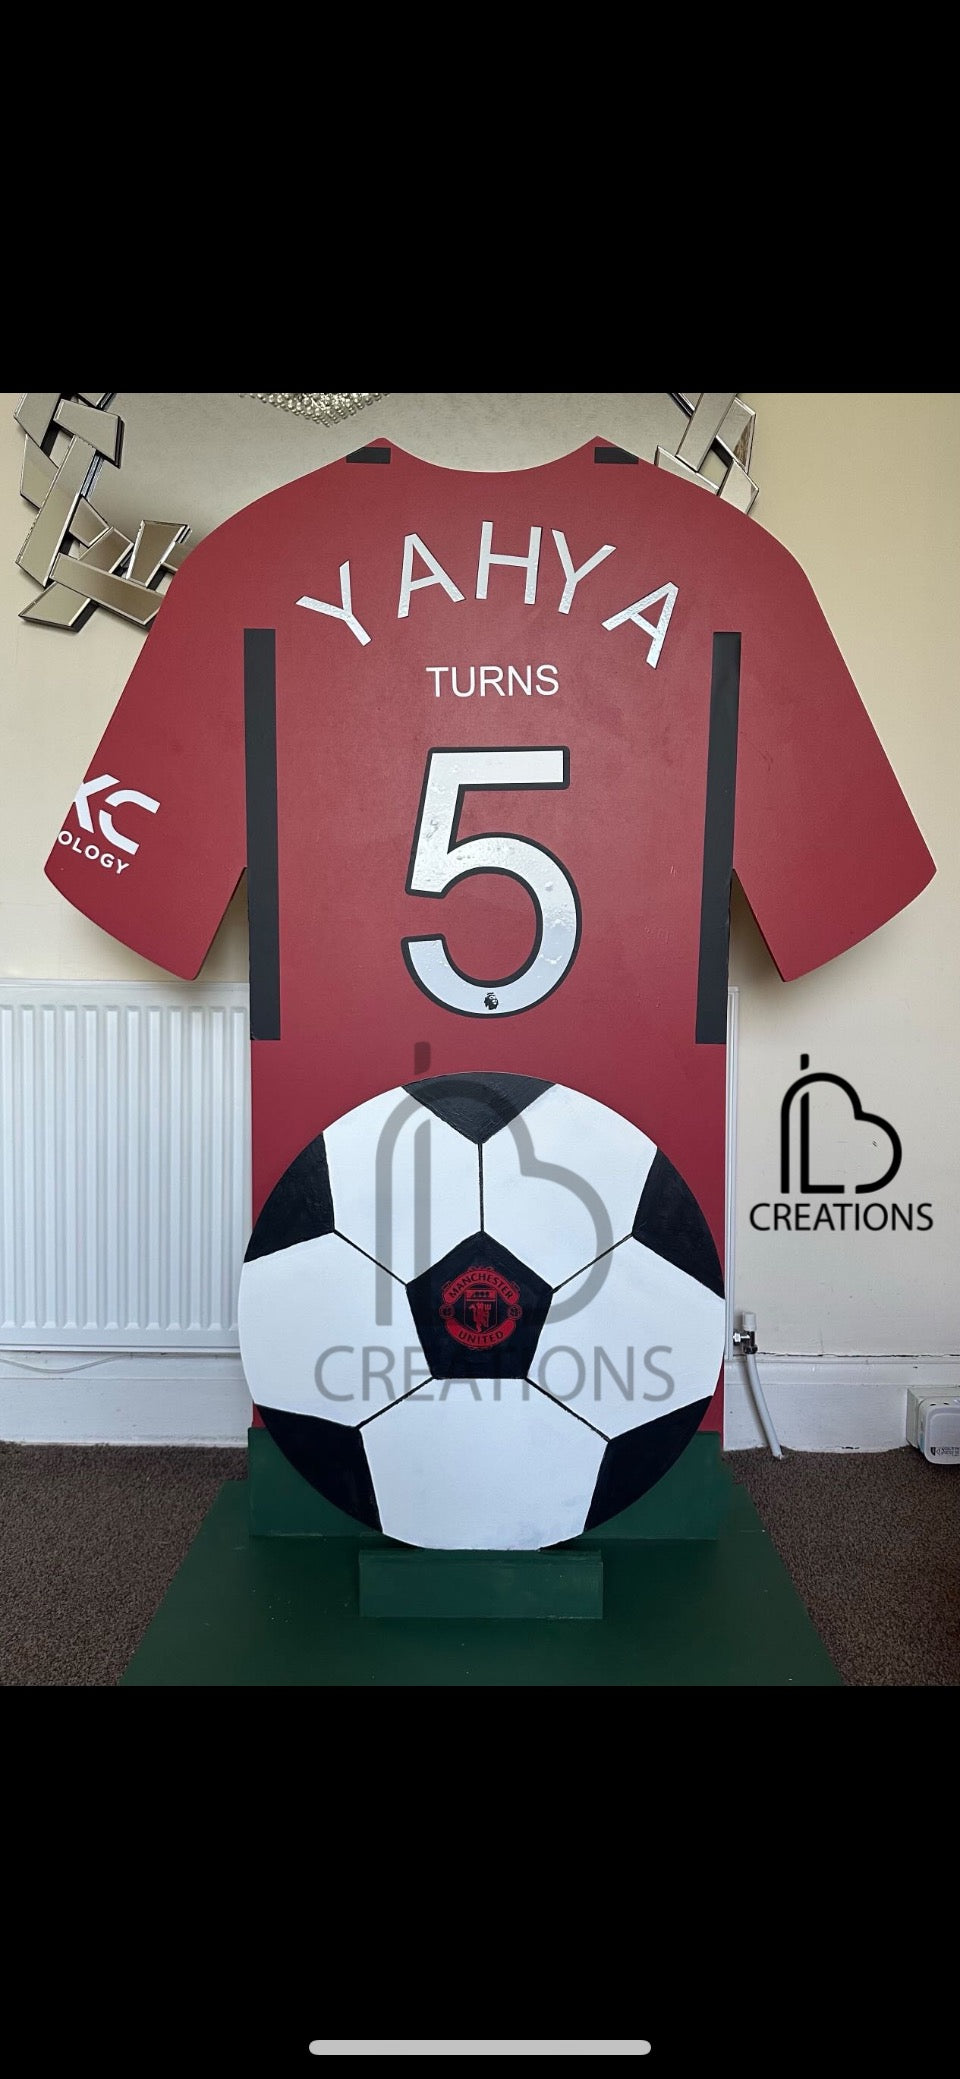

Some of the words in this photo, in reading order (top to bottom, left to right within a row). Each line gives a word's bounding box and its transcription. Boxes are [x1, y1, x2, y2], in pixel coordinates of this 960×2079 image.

[296, 520, 679, 669] YAHYA
[426, 664, 560, 698] TURNS
[58, 830, 130, 874] OLOGY
[401, 746, 582, 1019] 5
[448, 1272, 514, 1300] MANCHESTER
[458, 1330, 504, 1345] UNITED
